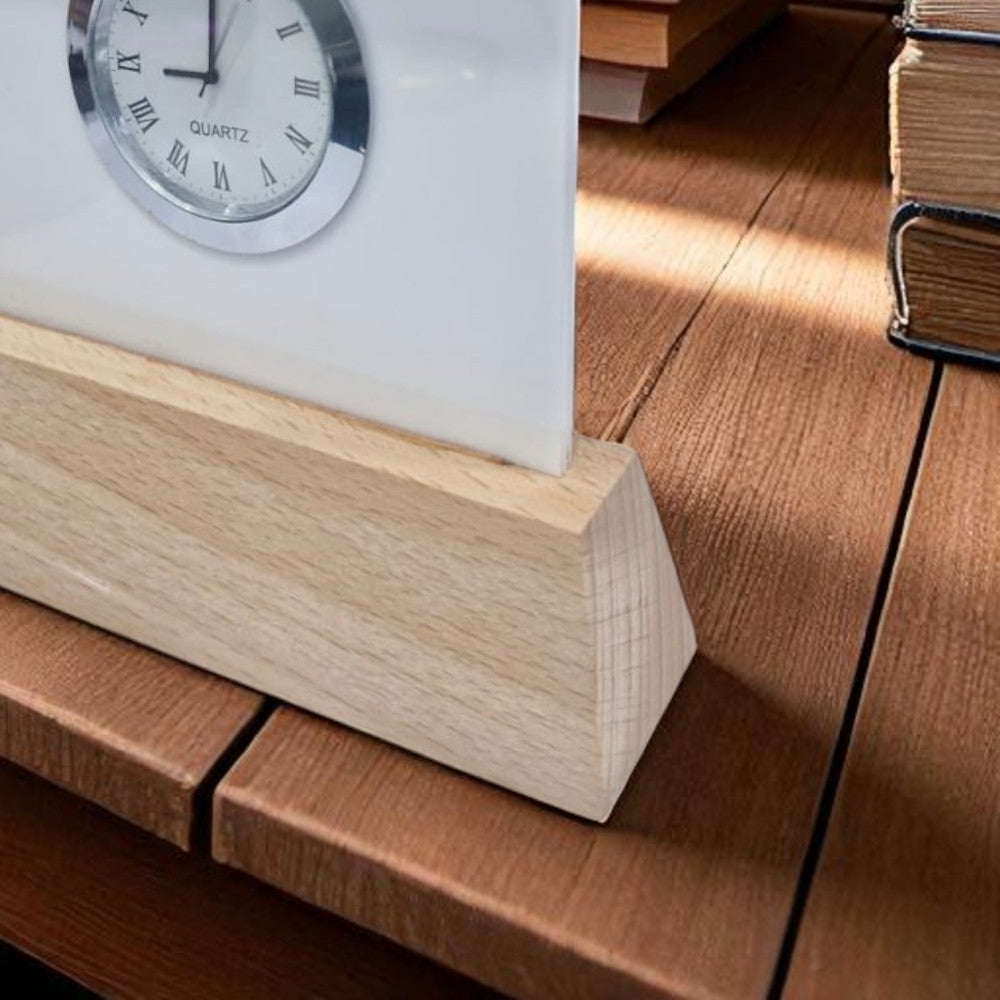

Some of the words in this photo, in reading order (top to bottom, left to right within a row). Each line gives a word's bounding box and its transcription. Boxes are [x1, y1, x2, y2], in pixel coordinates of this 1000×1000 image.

[122, 0, 149, 26] X
[275, 21, 304, 41] II
[117, 50, 141, 74] IX
[294, 76, 321, 99] III
[127, 96, 160, 134] VIII
[190, 120, 250, 143] QUARTZ
[284, 124, 314, 155] IV
[166, 139, 191, 177] VII
[212, 161, 231, 192] VI
[259, 157, 278, 188] V
